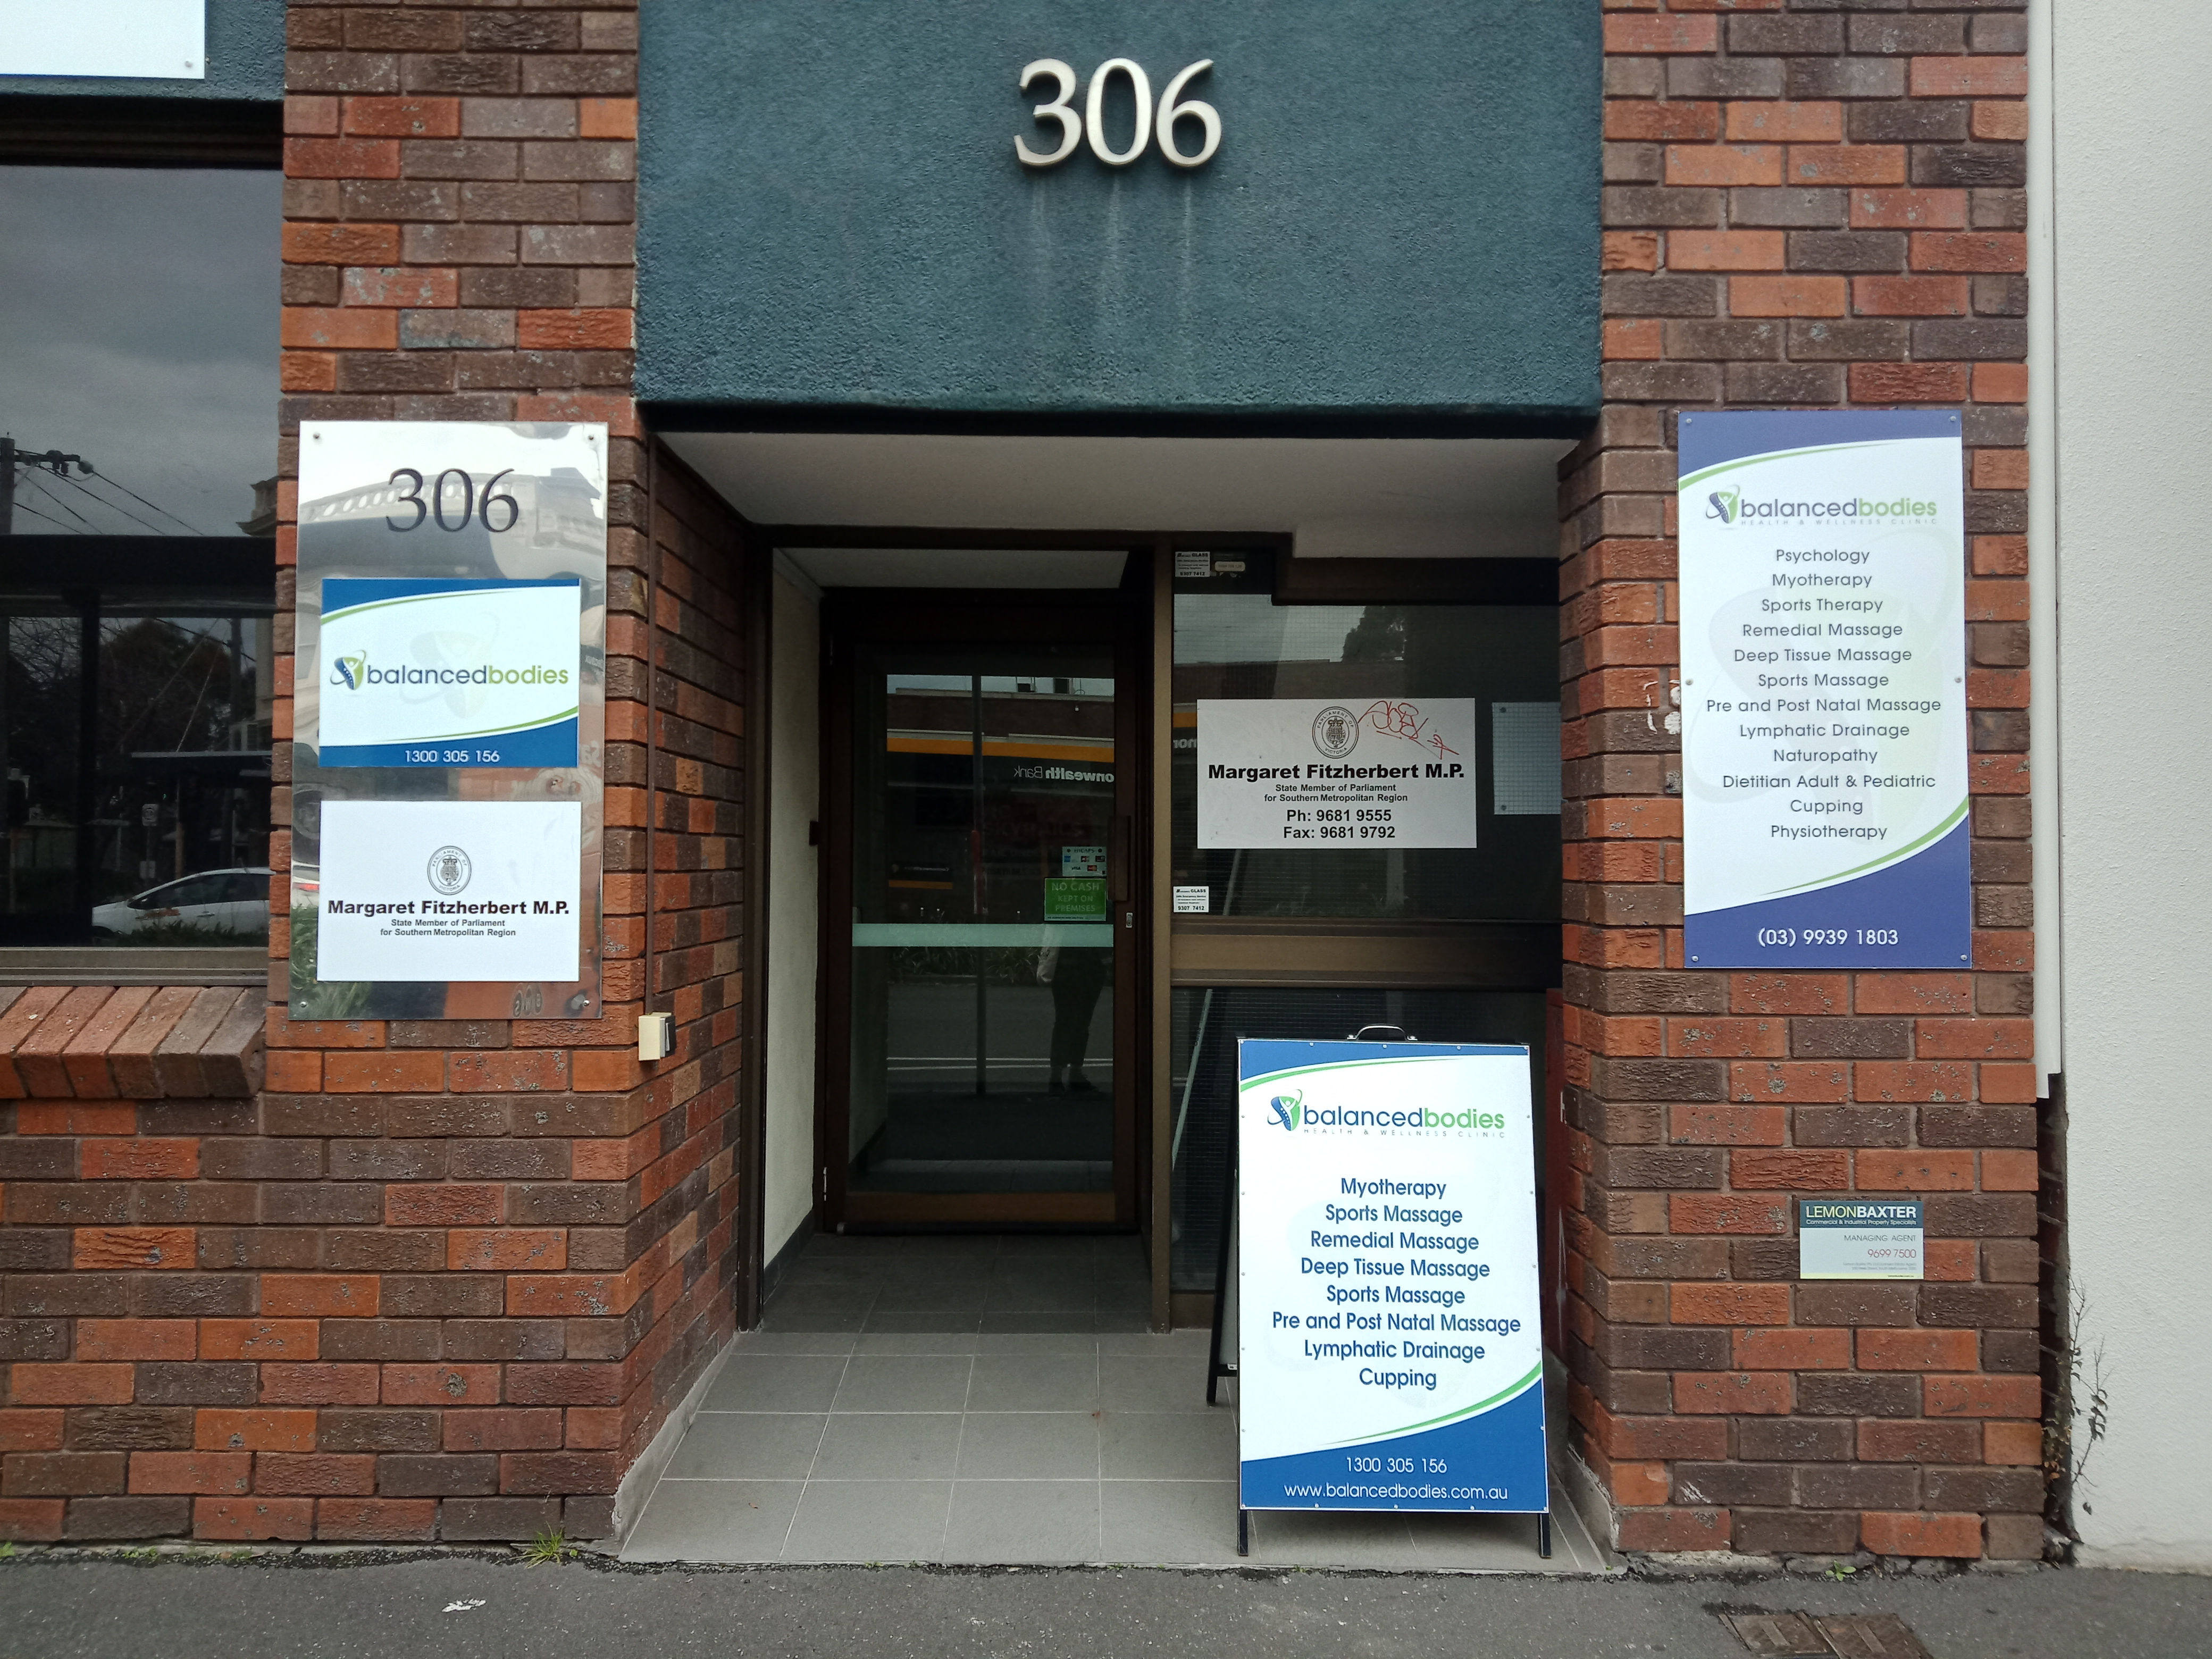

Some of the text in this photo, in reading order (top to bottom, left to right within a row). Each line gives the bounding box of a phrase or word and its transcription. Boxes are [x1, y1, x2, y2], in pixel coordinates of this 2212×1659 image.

[1013, 57, 1222, 166] 306
[386, 467, 520, 533] 306
[1741, 498, 1937, 518] balancedbodies
[1776, 549, 1870, 565] Psychology
[1772, 573, 1872, 589] Myotherapy
[1762, 598, 1883, 614] Sports Therapy
[1743, 623, 1903, 639] Remedial Massage
[1735, 648, 1912, 664] Deep Tissue Massage
[367, 665, 568, 684] balancedbodies
[1758, 674, 1889, 689] Sports Massage
[1707, 698, 1941, 714] Pre and Post Natal Massage
[1317, 711, 1348, 728] PARLIAMENT
[1740, 724, 1909, 739] Lymphatic Drainage
[405, 750, 500, 763] 1300 305 156
[1774, 749, 1878, 764] Naturopathy
[1209, 763, 1464, 783] Margaret Fitzherbert M.P.
[1338, 783, 1347, 792] of
[1350, 783, 1396, 792] Parliament
[1723, 775, 1936, 788] Dietitian Adult & Pediatric
[1320, 793, 1374, 803] Metropolitan
[1377, 793, 1408, 803] Region
[1790, 799, 1863, 815] Cupping
[1287, 809, 1392, 822] Ph: 9681 9555
[1284, 826, 1395, 839] Fax: 9681 9792
[1771, 825, 1888, 840] Physiotherapy
[432, 850, 462, 867] PARLIAMENT
[1052, 882, 1100, 891] NO CASH
[328, 900, 569, 917] Margaret Fitzherbert M.P.
[433, 928, 484, 937] Metropolitan
[487, 928, 516, 937] Region
[1758, 927, 1898, 947] (03) 9939 1803
[1304, 1105, 1504, 1128] balancedbodies
[1341, 1177, 1447, 1200] Myotherapy
[1326, 1203, 1463, 1227] Sports Massage
[1806, 1205, 1916, 1218] LEMONBAXTER
[1311, 1230, 1479, 1254] Remedial Massage
[1867, 1249, 1917, 1259] 9699 7500
[1301, 1257, 1490, 1281] Deep Tissue Massage
[1327, 1284, 1465, 1308] Sports Massage
[1273, 1311, 1521, 1337] Pre and Post Natal Massage
[1305, 1339, 1485, 1364] Lymphatic Drainage
[1359, 1368, 1437, 1391] Cupping
[1346, 1457, 1447, 1473] 1300 305 156
[1284, 1482, 1508, 1499] www.balancedbodies.com.au
